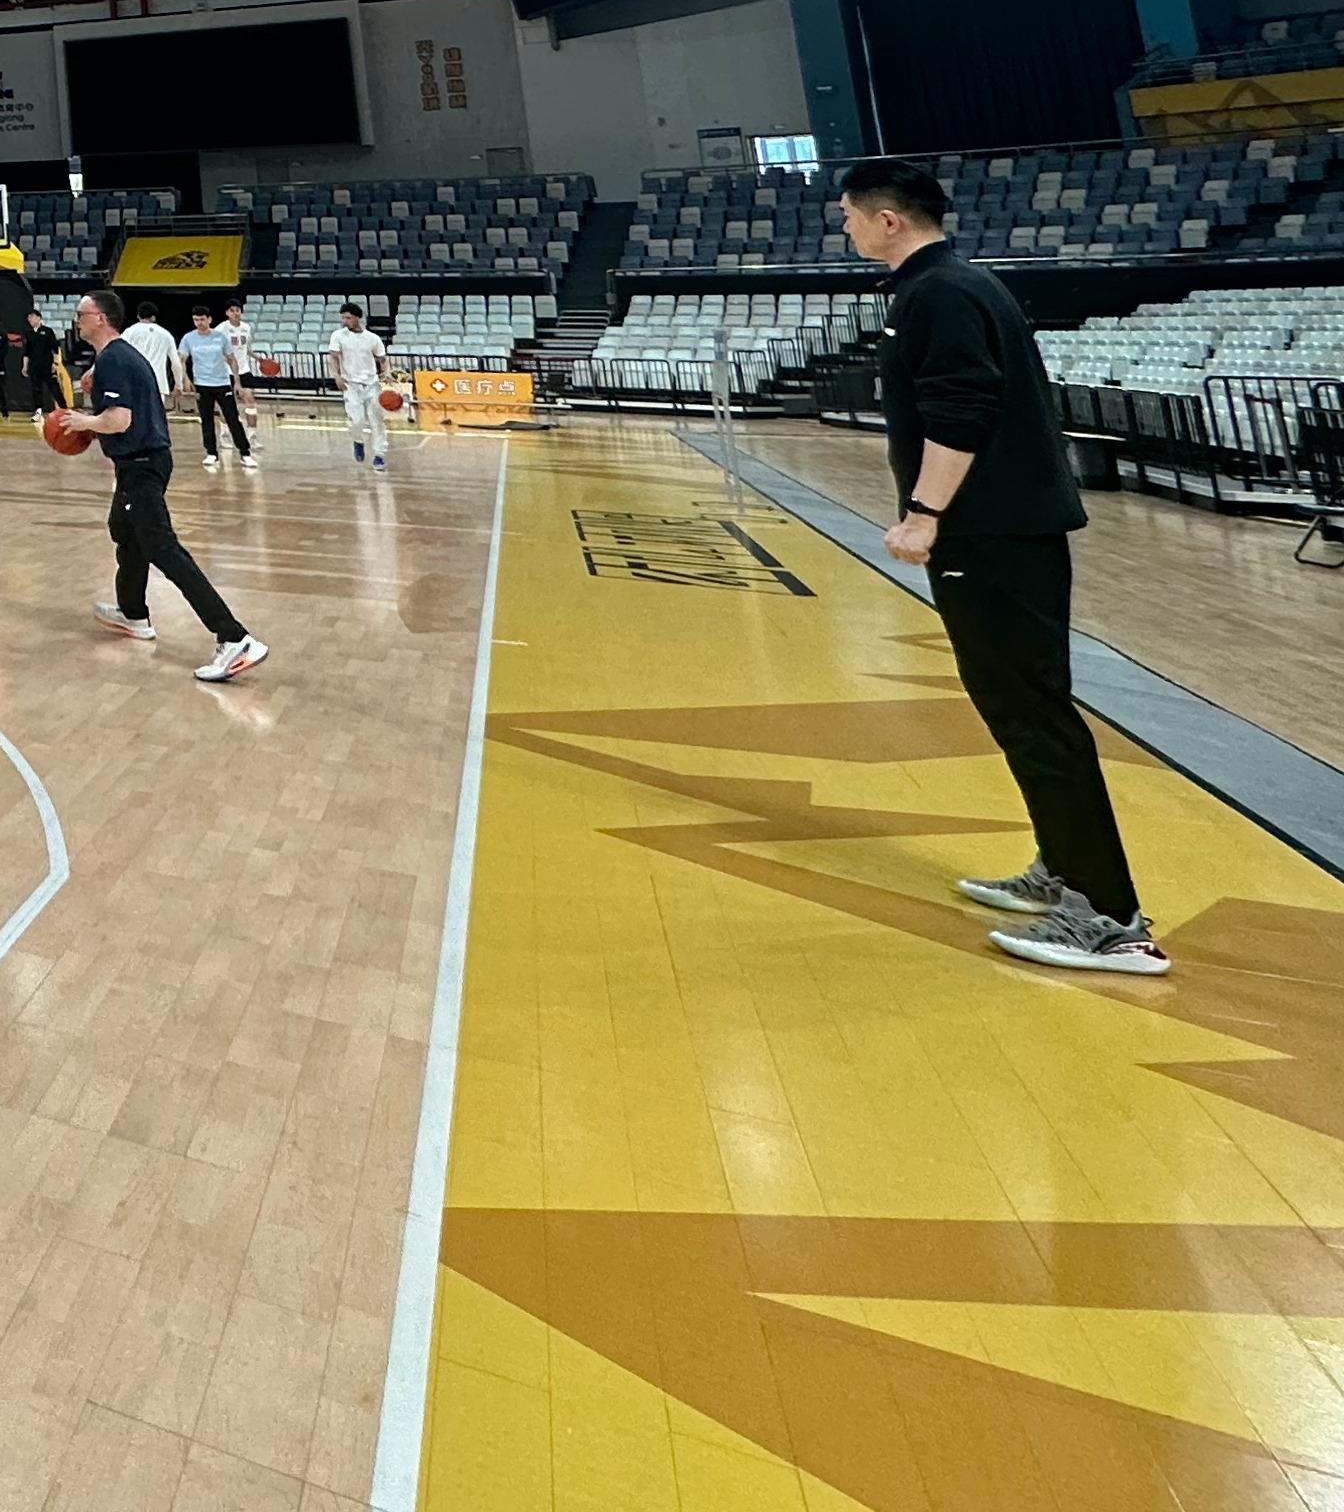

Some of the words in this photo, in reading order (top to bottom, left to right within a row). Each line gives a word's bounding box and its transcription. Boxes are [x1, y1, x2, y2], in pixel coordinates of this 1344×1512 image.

[6, 123, 36, 132] Centre
[454, 378, 517, 396] 医疗点
